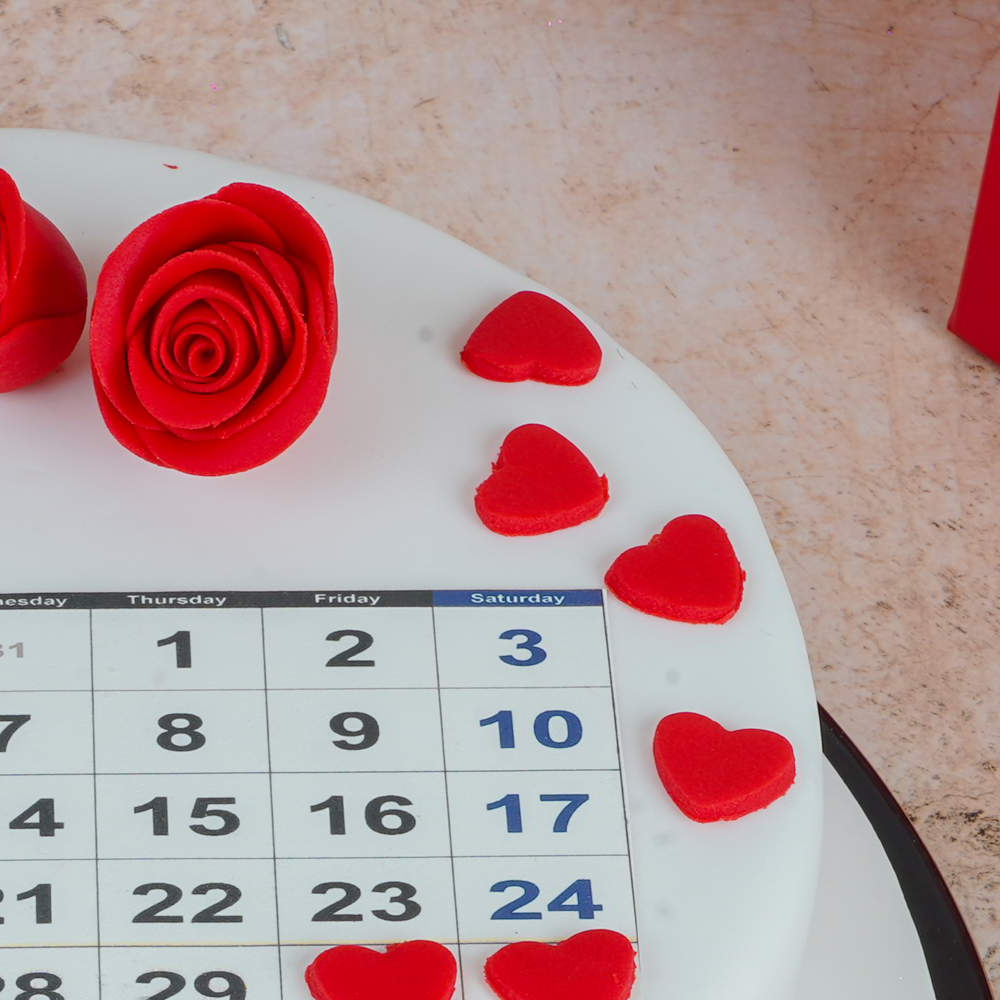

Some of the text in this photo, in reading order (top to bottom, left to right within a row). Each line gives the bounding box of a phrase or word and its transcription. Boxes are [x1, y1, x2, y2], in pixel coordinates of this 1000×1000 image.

[127, 594, 227, 607] Thursday
[314, 593, 381, 606] Friday
[470, 592, 566, 606] Saturday
[157, 631, 192, 668] 1
[325, 629, 375, 667] 2
[498, 629, 547, 666] 3
[156, 713, 206, 751] 8
[329, 712, 380, 751] 9
[479, 710, 583, 748] 10
[133, 797, 240, 836] 15
[310, 795, 417, 835] 16
[486, 794, 590, 833] 17
[131, 883, 243, 923] 22
[311, 881, 422, 921] 23
[489, 879, 603, 920] 24
